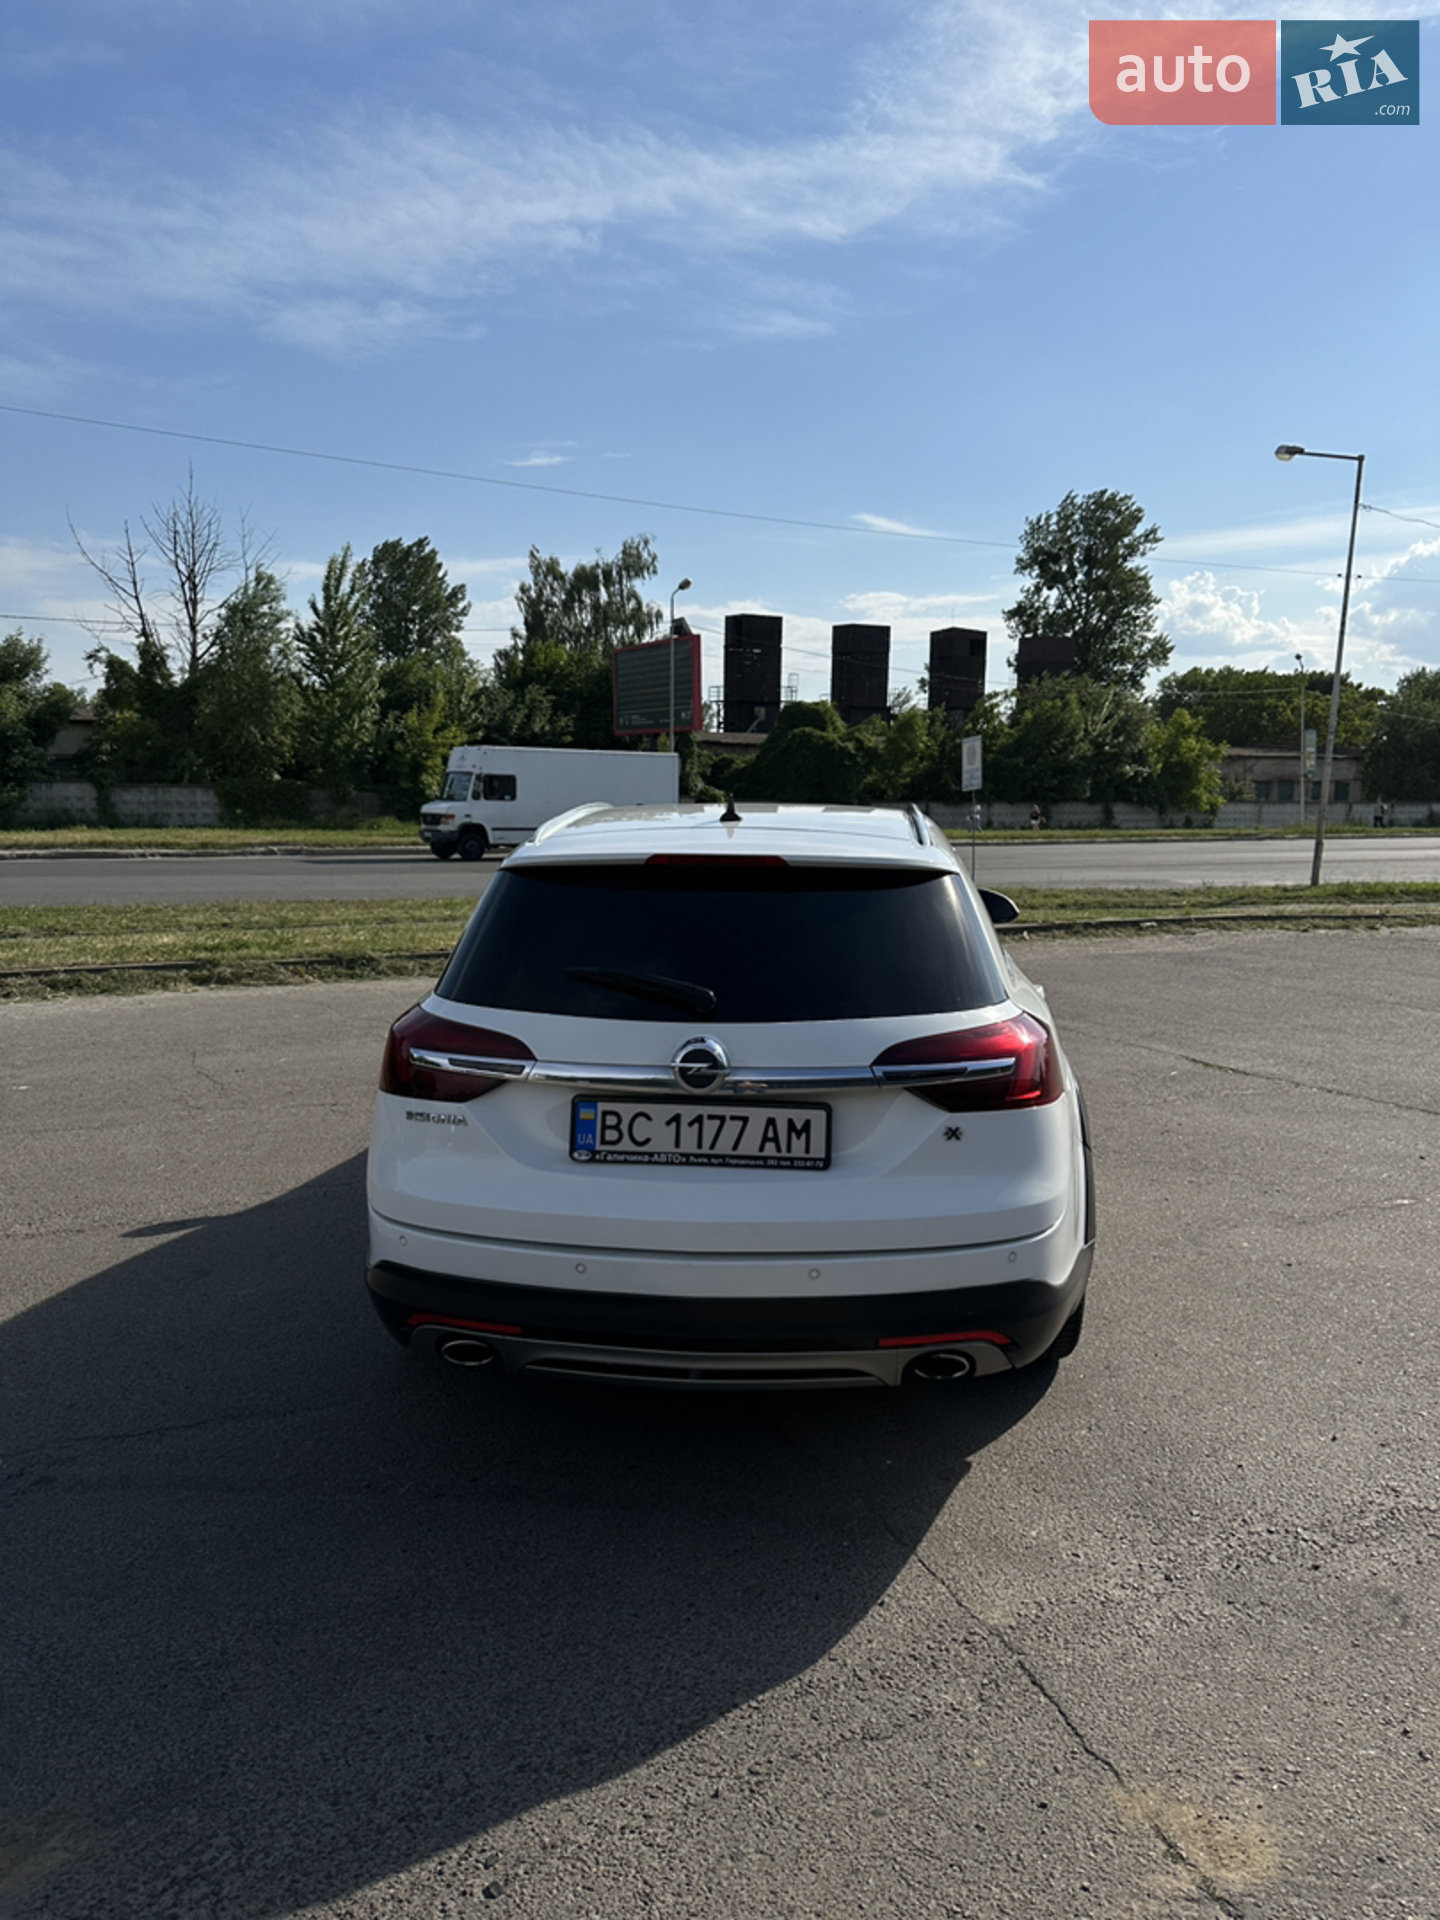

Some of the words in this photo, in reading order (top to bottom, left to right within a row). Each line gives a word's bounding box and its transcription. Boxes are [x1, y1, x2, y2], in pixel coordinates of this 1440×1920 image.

[577, 1133, 595, 1145] UA
[600, 1110, 653, 1147] BC
[664, 1112, 750, 1152] 1177
[758, 1116, 812, 1155] AM
